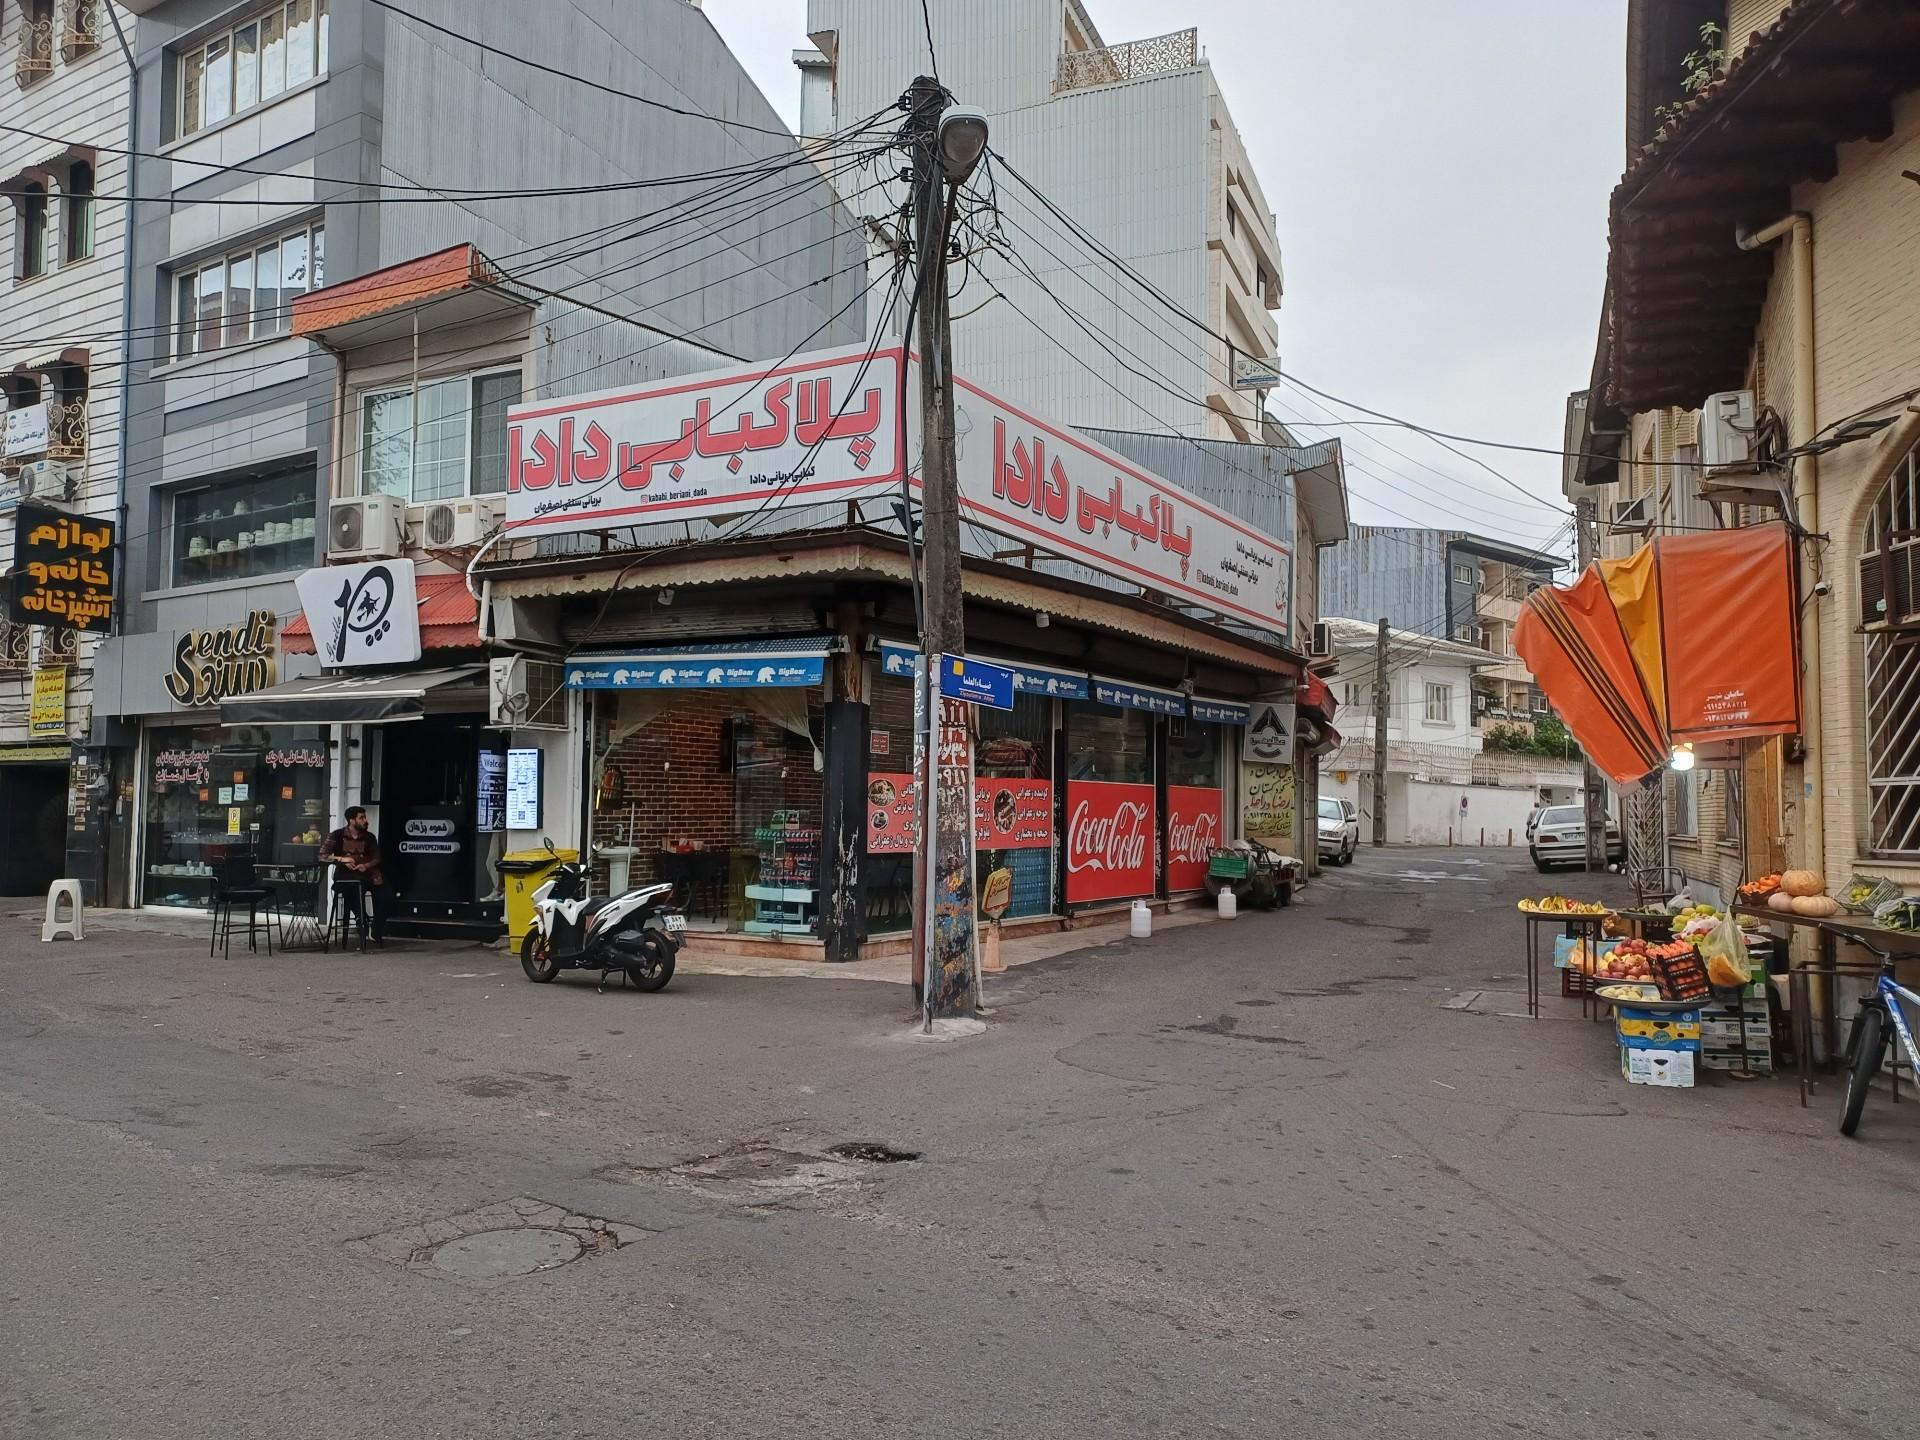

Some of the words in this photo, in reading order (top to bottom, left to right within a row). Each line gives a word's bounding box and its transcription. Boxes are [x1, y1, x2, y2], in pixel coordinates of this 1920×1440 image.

[507, 416, 612, 494] دادا
[992, 415, 1070, 523] دادا
[749, 473, 767, 485] دادا
[767, 470, 791, 486] بریانی
[582, 496, 602, 509] بریانی
[27, 518, 111, 554] لوازم
[27, 561, 48, 585] و
[48, 557, 109, 586] خانه
[21, 587, 113, 629] آشپزخانه
[163, 607, 270, 707] Sendi
[726, 668, 755, 678] BigBear
[778, 667, 806, 677] BigBear
[1067, 799, 1150, 874] Coca-Cola
